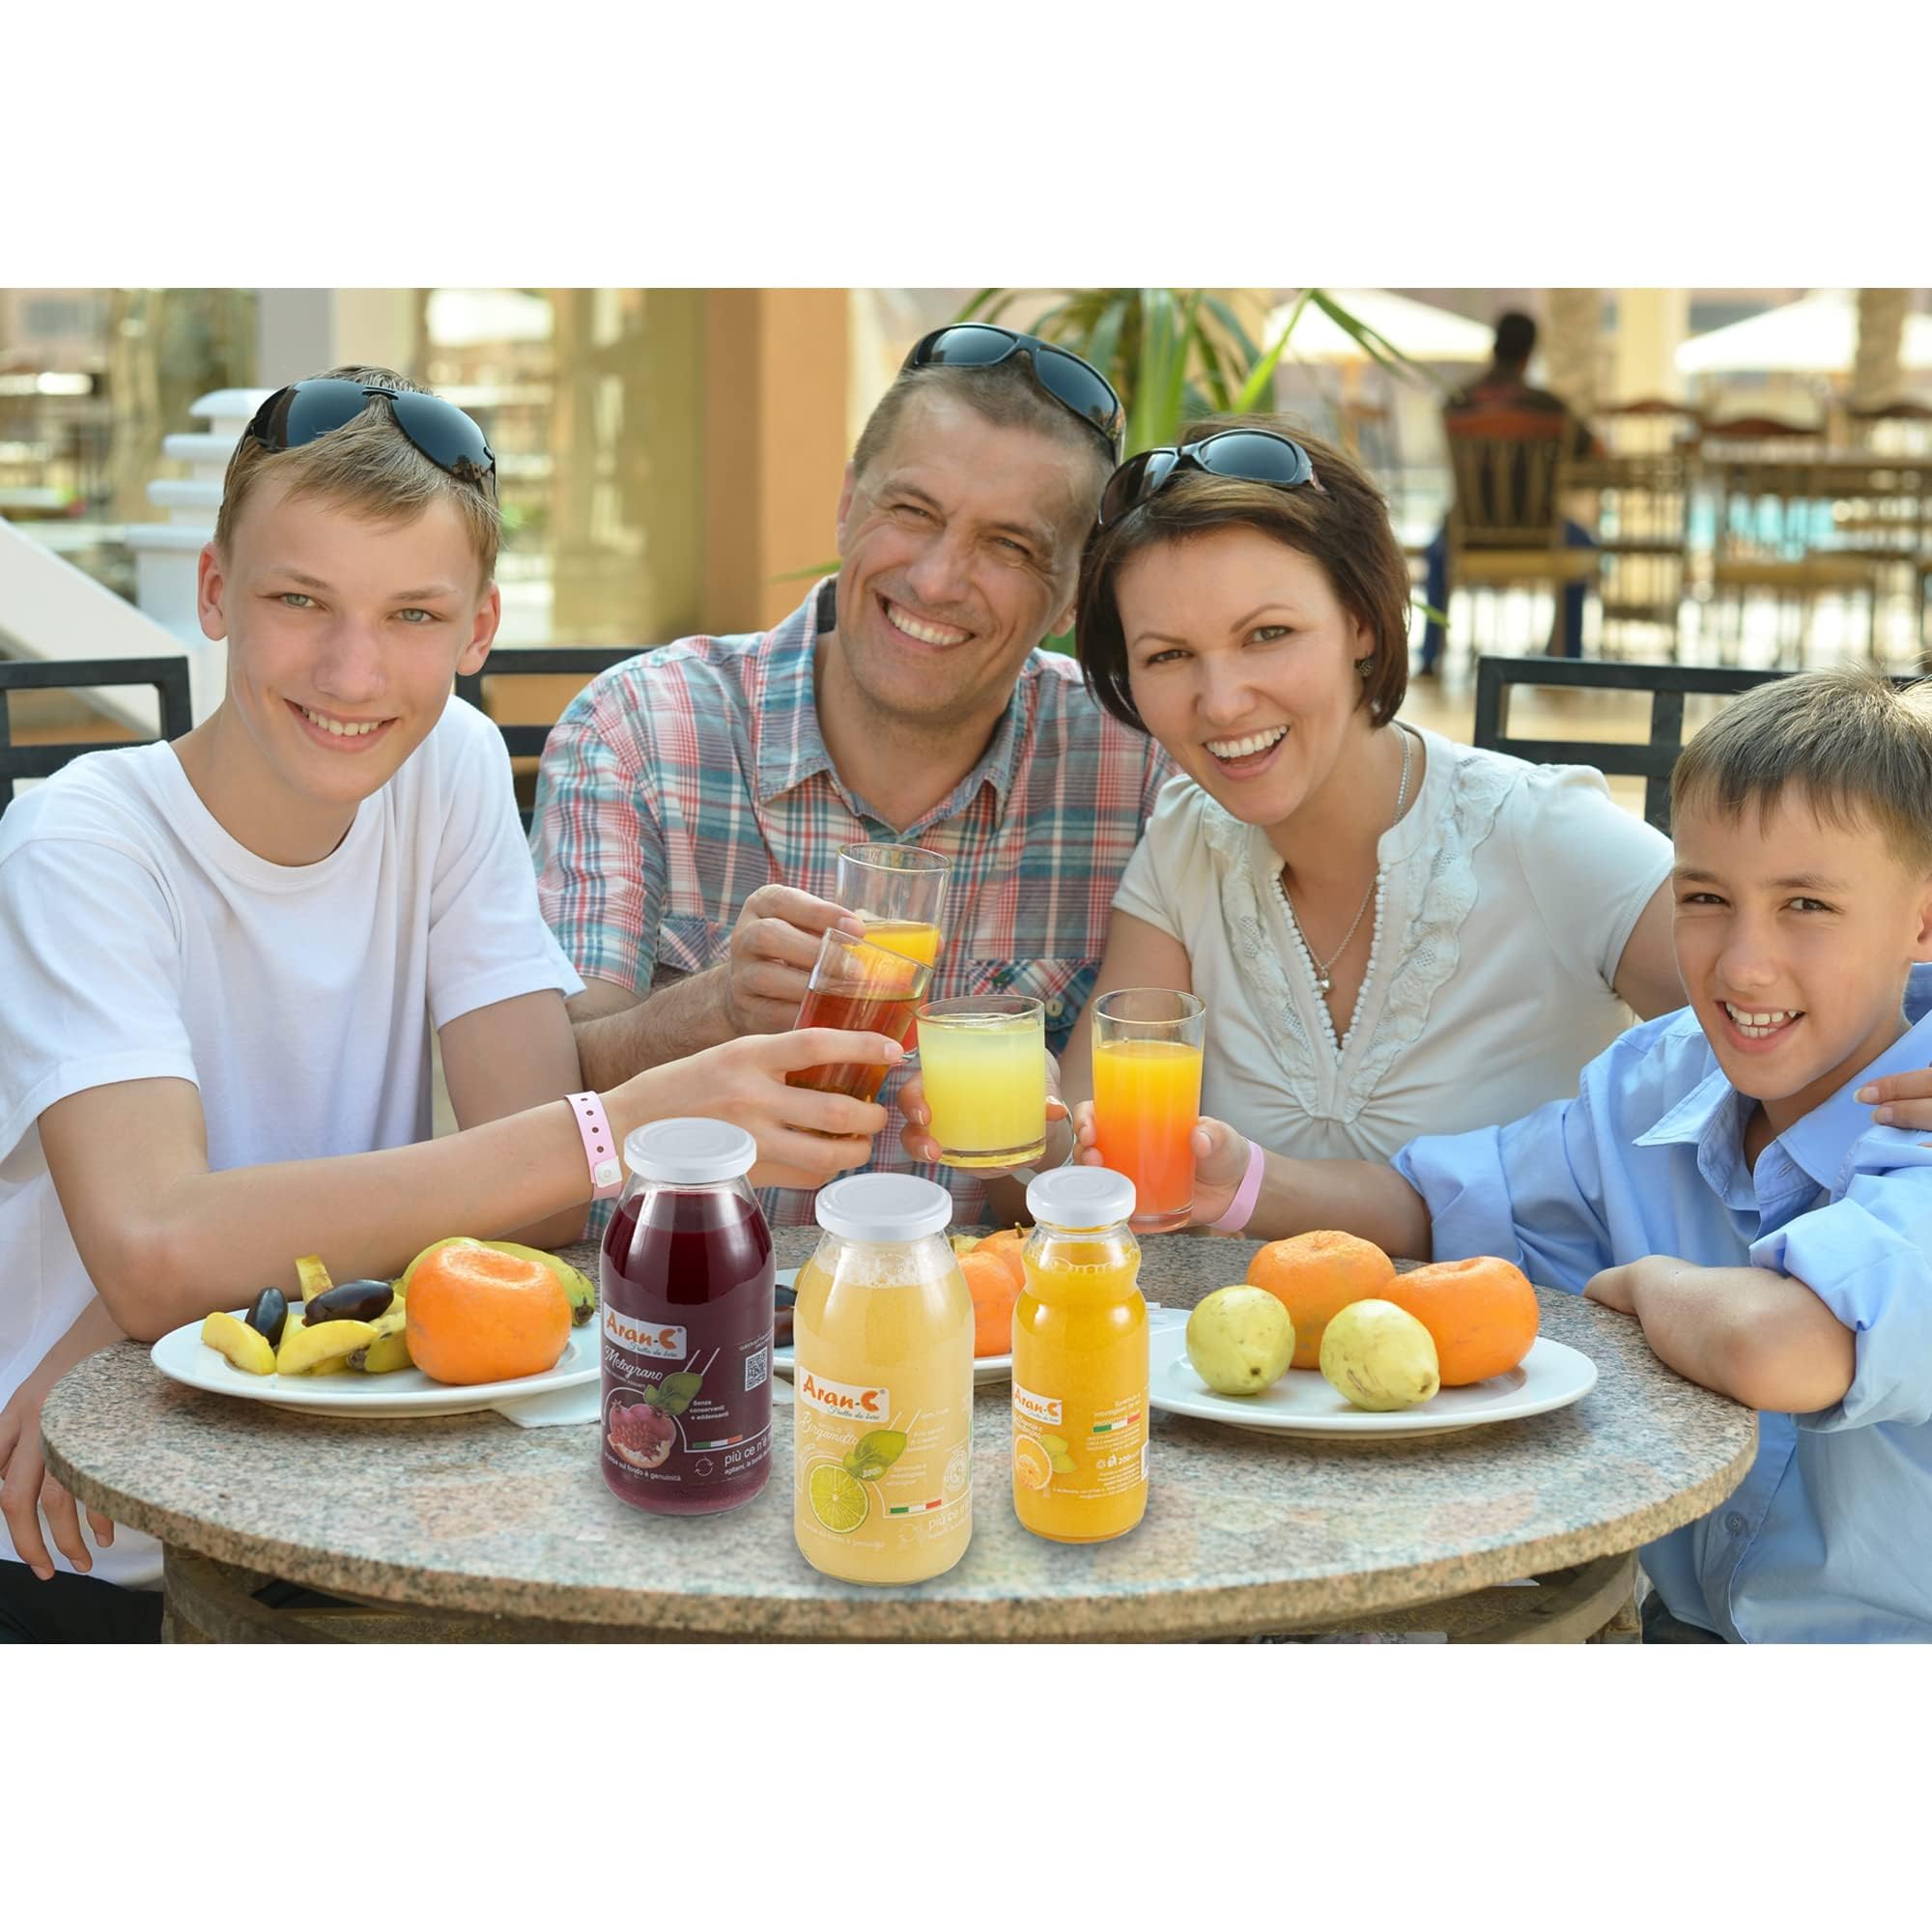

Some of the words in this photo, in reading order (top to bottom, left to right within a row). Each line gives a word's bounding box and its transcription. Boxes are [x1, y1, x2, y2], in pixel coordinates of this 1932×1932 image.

[607, 1311, 677, 1350] Aran-C
[604, 1345, 664, 1381] Melograno
[803, 1375, 880, 1412] Aran-C
[724, 1449, 742, 1467] più
[744, 1446, 755, 1458] ce
